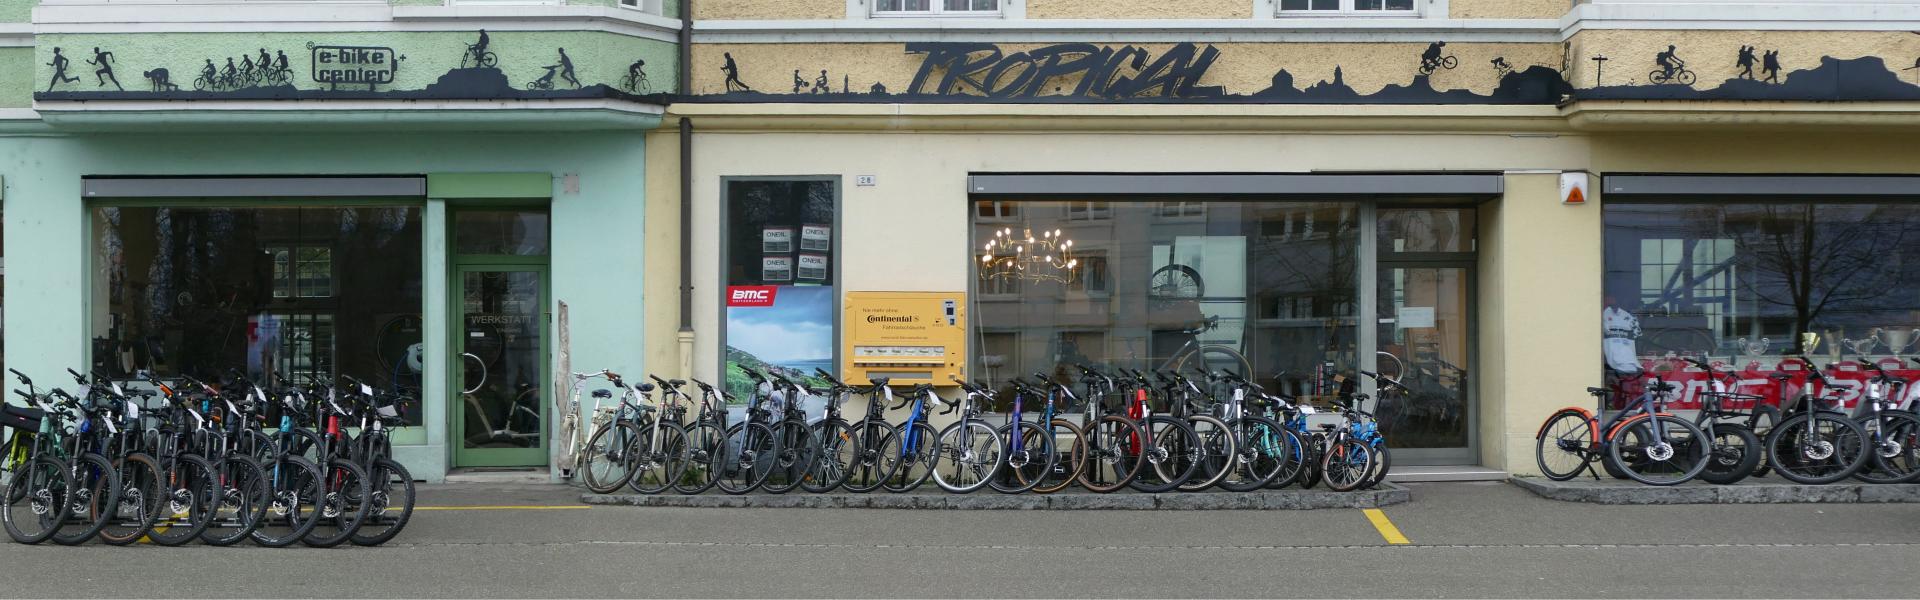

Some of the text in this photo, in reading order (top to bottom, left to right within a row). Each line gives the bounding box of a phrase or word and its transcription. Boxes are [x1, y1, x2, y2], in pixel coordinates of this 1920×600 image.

[320, 48, 384, 64] e-bike
[320, 67, 389, 82] center
[904, 42, 1226, 97] TROPICAL
[732, 289, 769, 299] BMC
[471, 315, 532, 324] WERKSTATT
[867, 314, 912, 323] Continental
